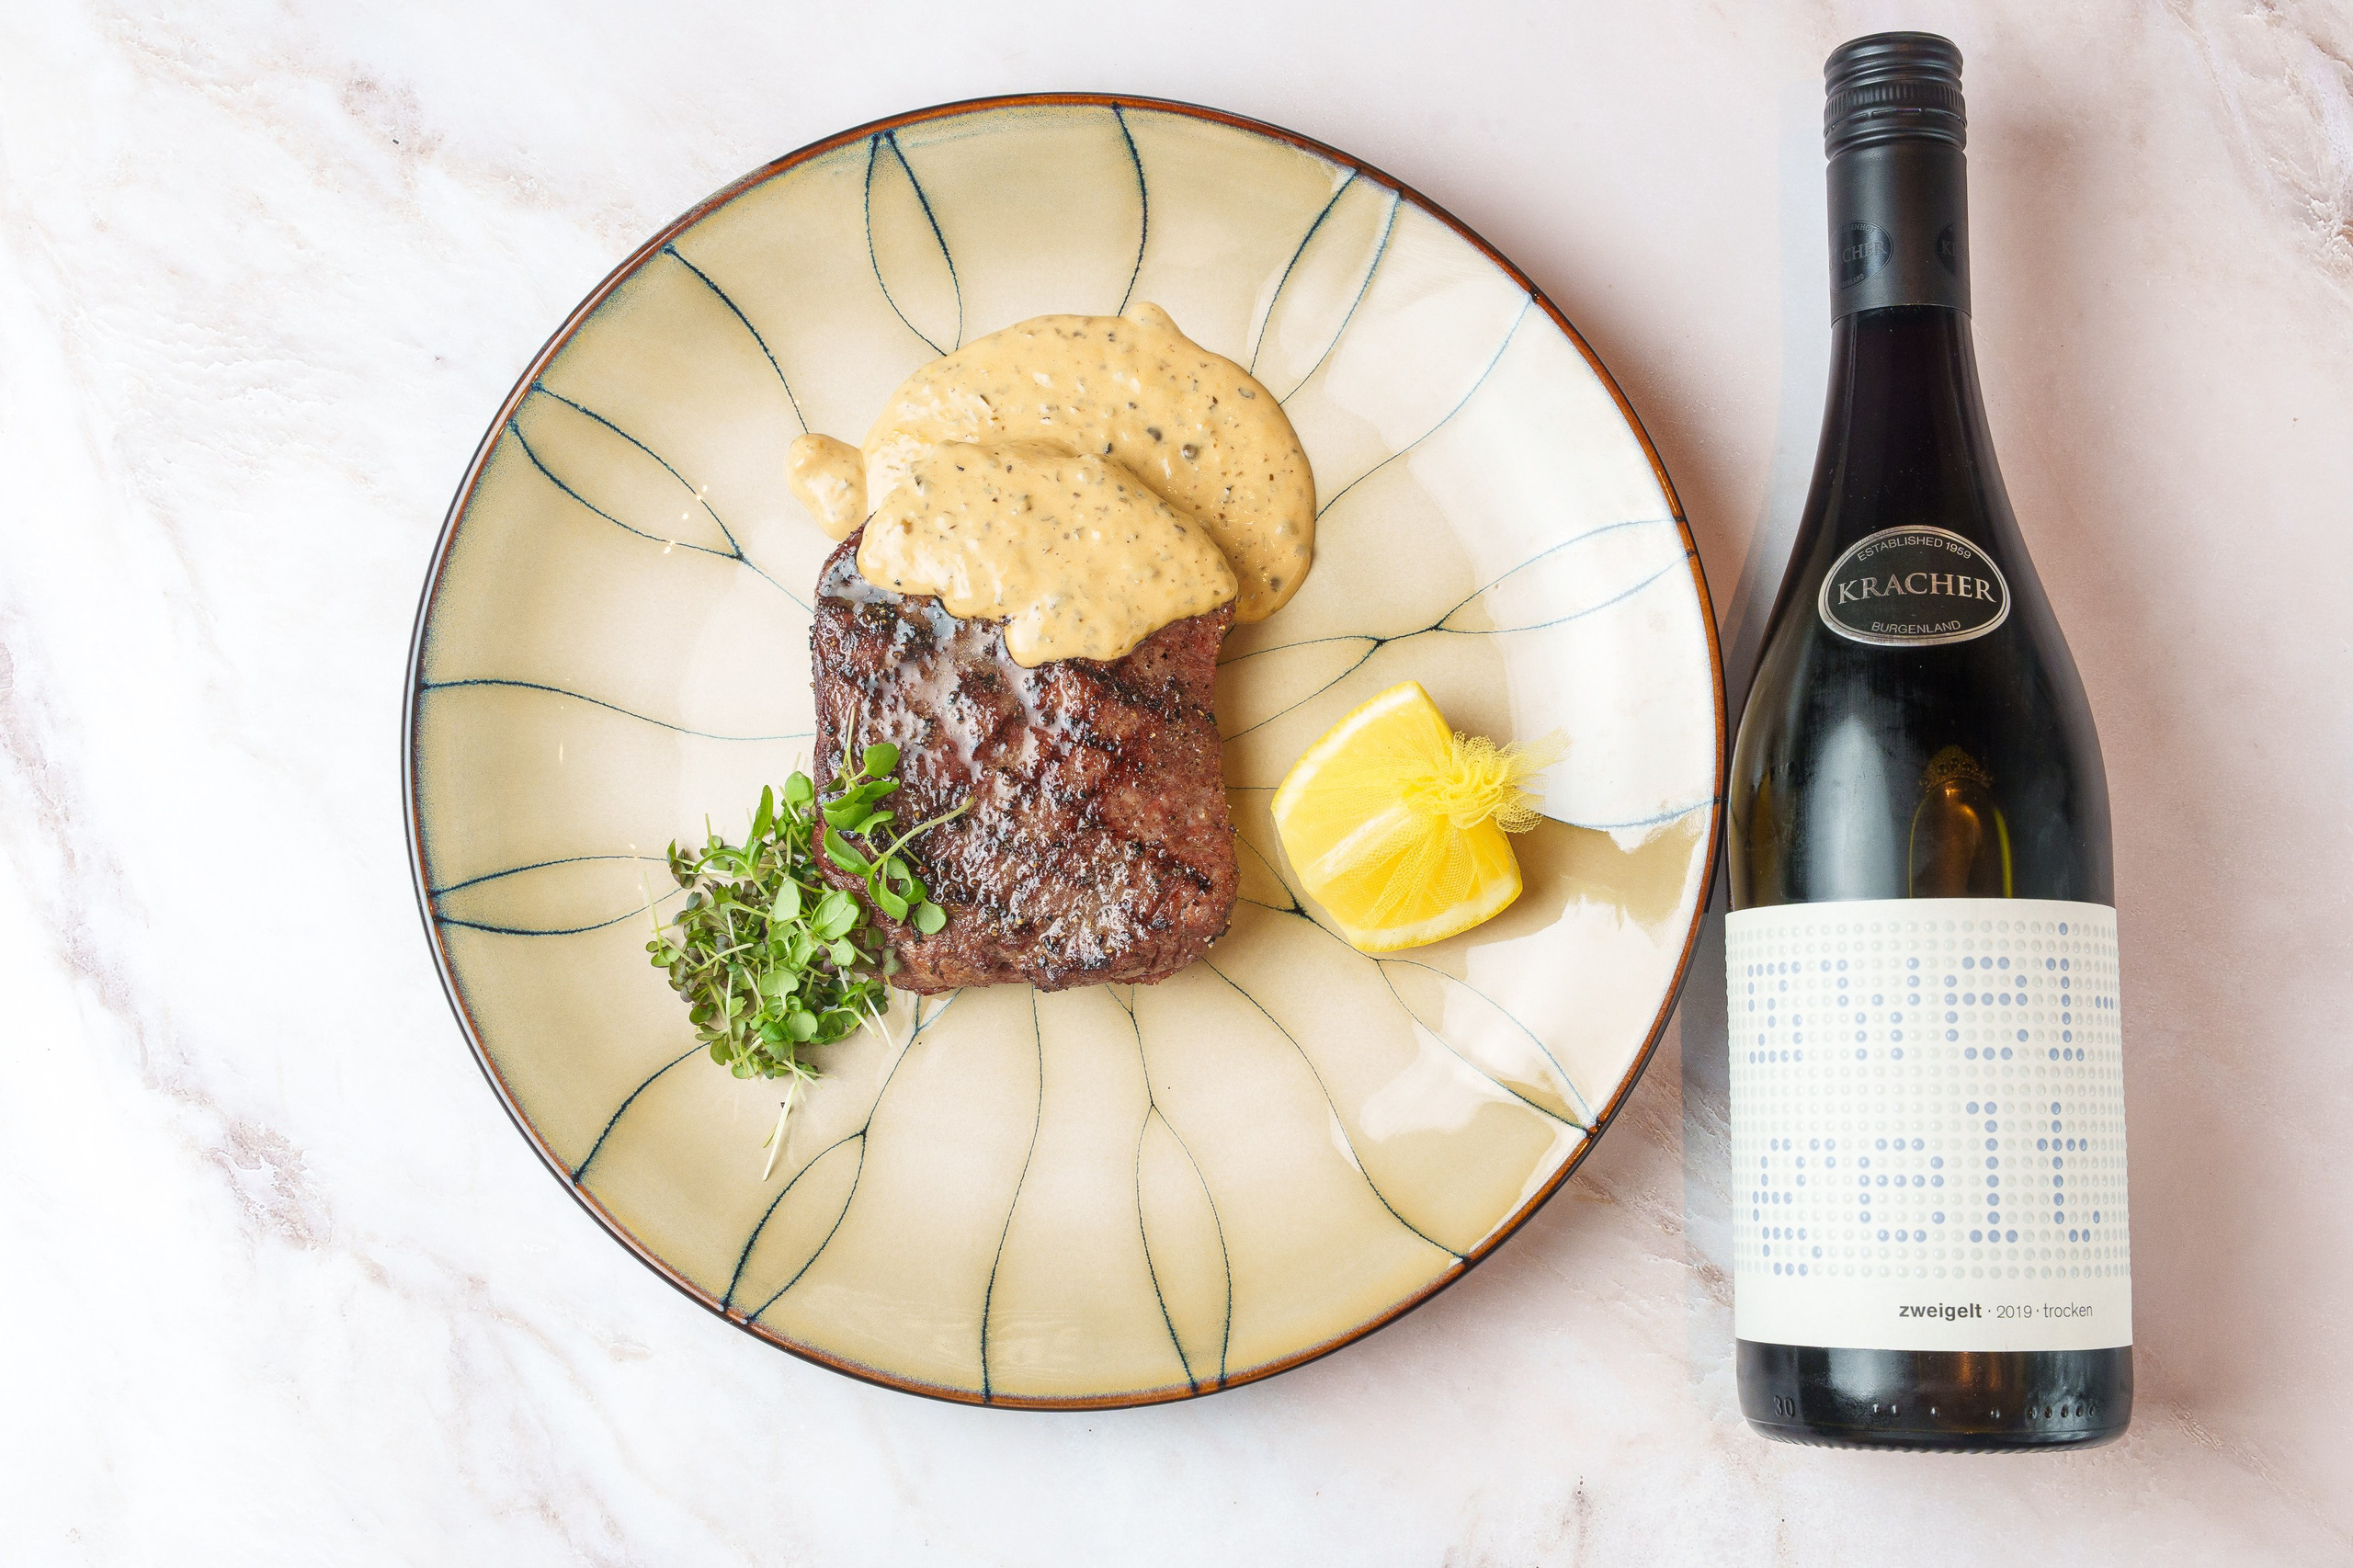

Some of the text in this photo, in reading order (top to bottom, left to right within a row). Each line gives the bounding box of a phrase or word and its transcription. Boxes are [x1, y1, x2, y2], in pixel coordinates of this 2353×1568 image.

[1857, 536, 1972, 562] ESTABLISHED 1959
[1838, 573, 1996, 605] KRACHER
[1871, 619, 1961, 634] BURGENLAND
[1899, 1302, 2093, 1321] zweigelt 2019 trocken
[1774, 1395, 1795, 1418] 30
